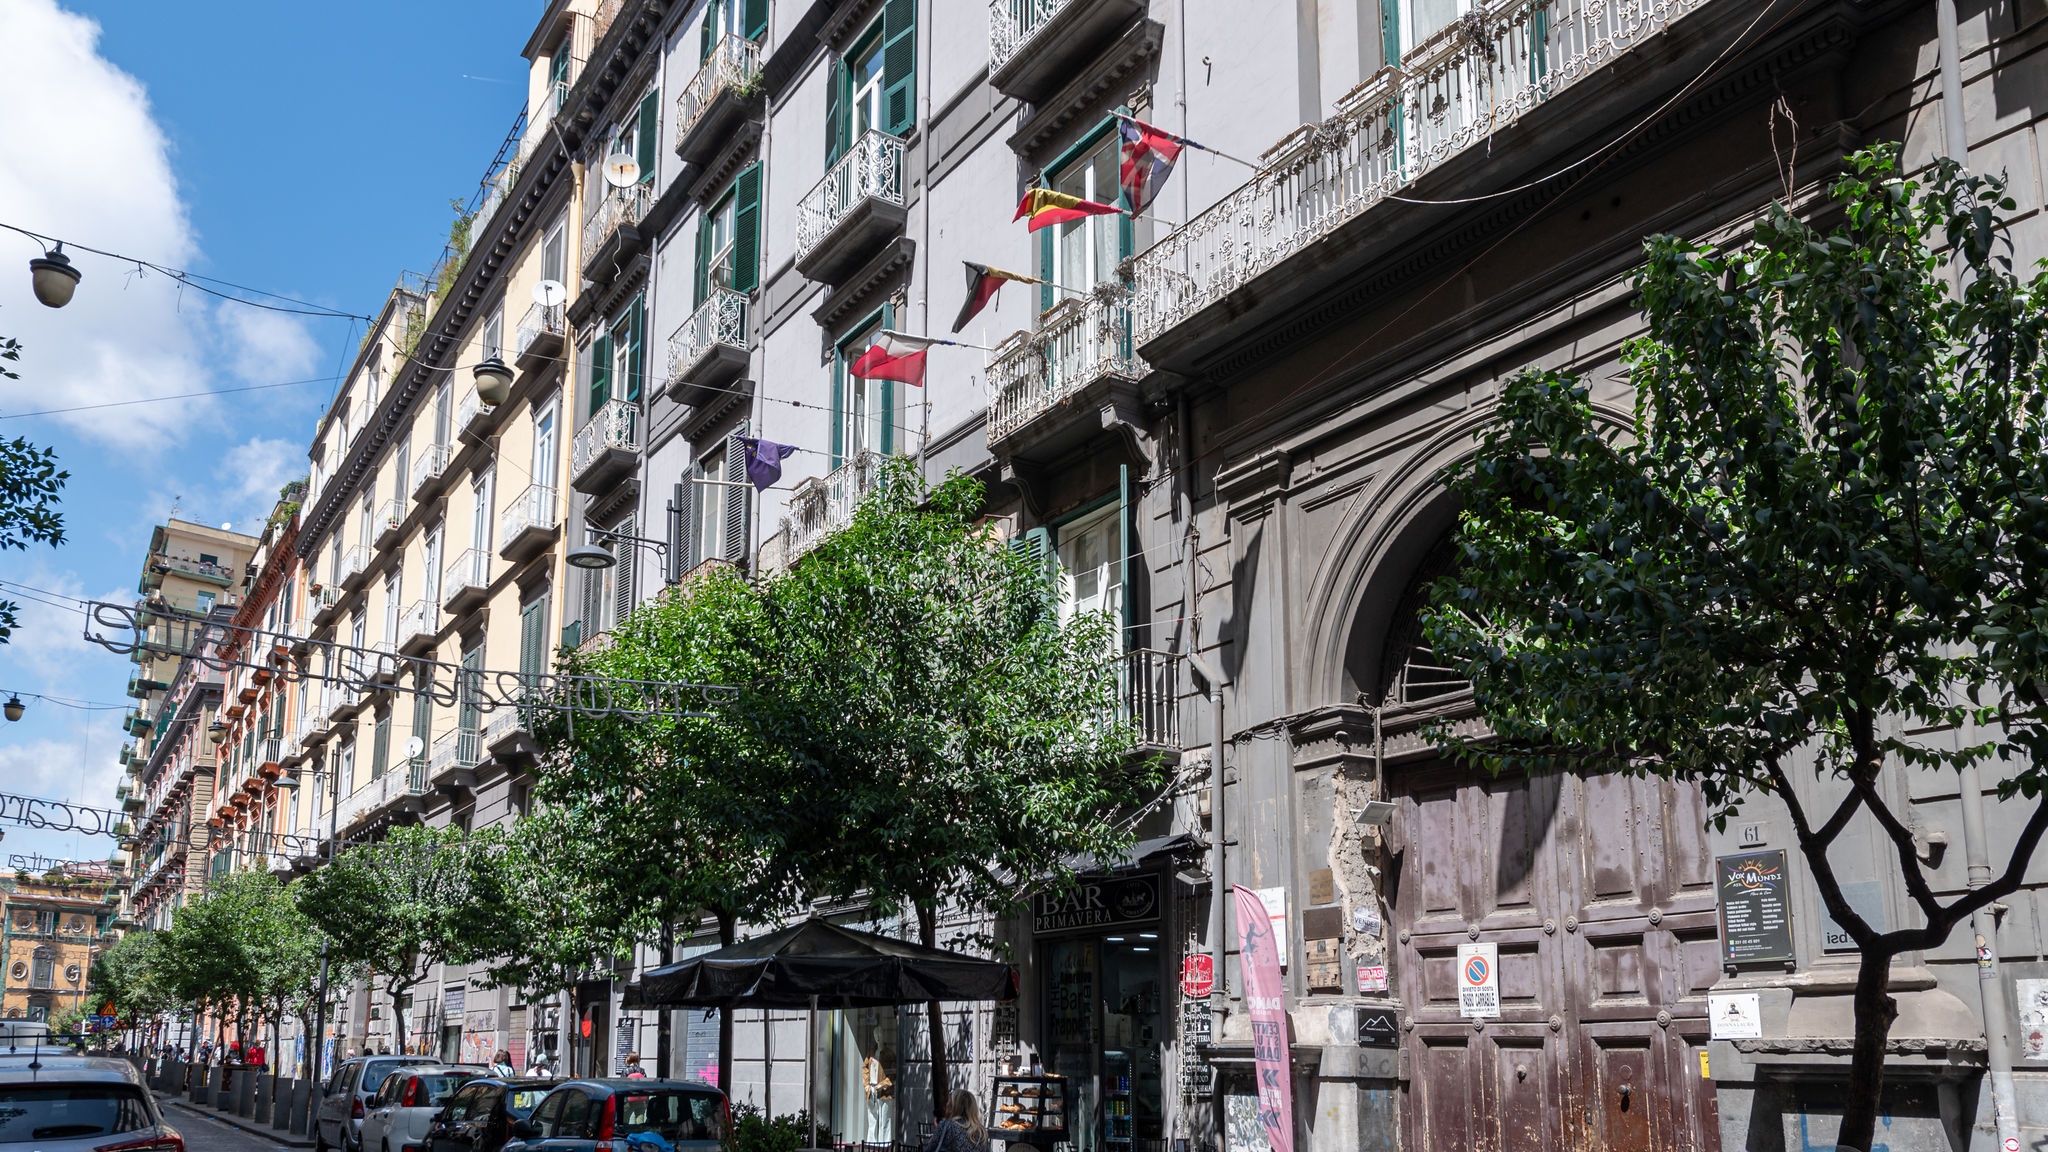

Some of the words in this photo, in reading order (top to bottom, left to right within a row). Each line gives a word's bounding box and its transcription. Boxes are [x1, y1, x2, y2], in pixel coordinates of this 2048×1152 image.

[1744, 825, 1760, 842] 61
[1745, 873, 1782, 884] MUNDI
[1042, 885, 1105, 916] BAR
[1035, 908, 1112, 931] PRIMAVERA
